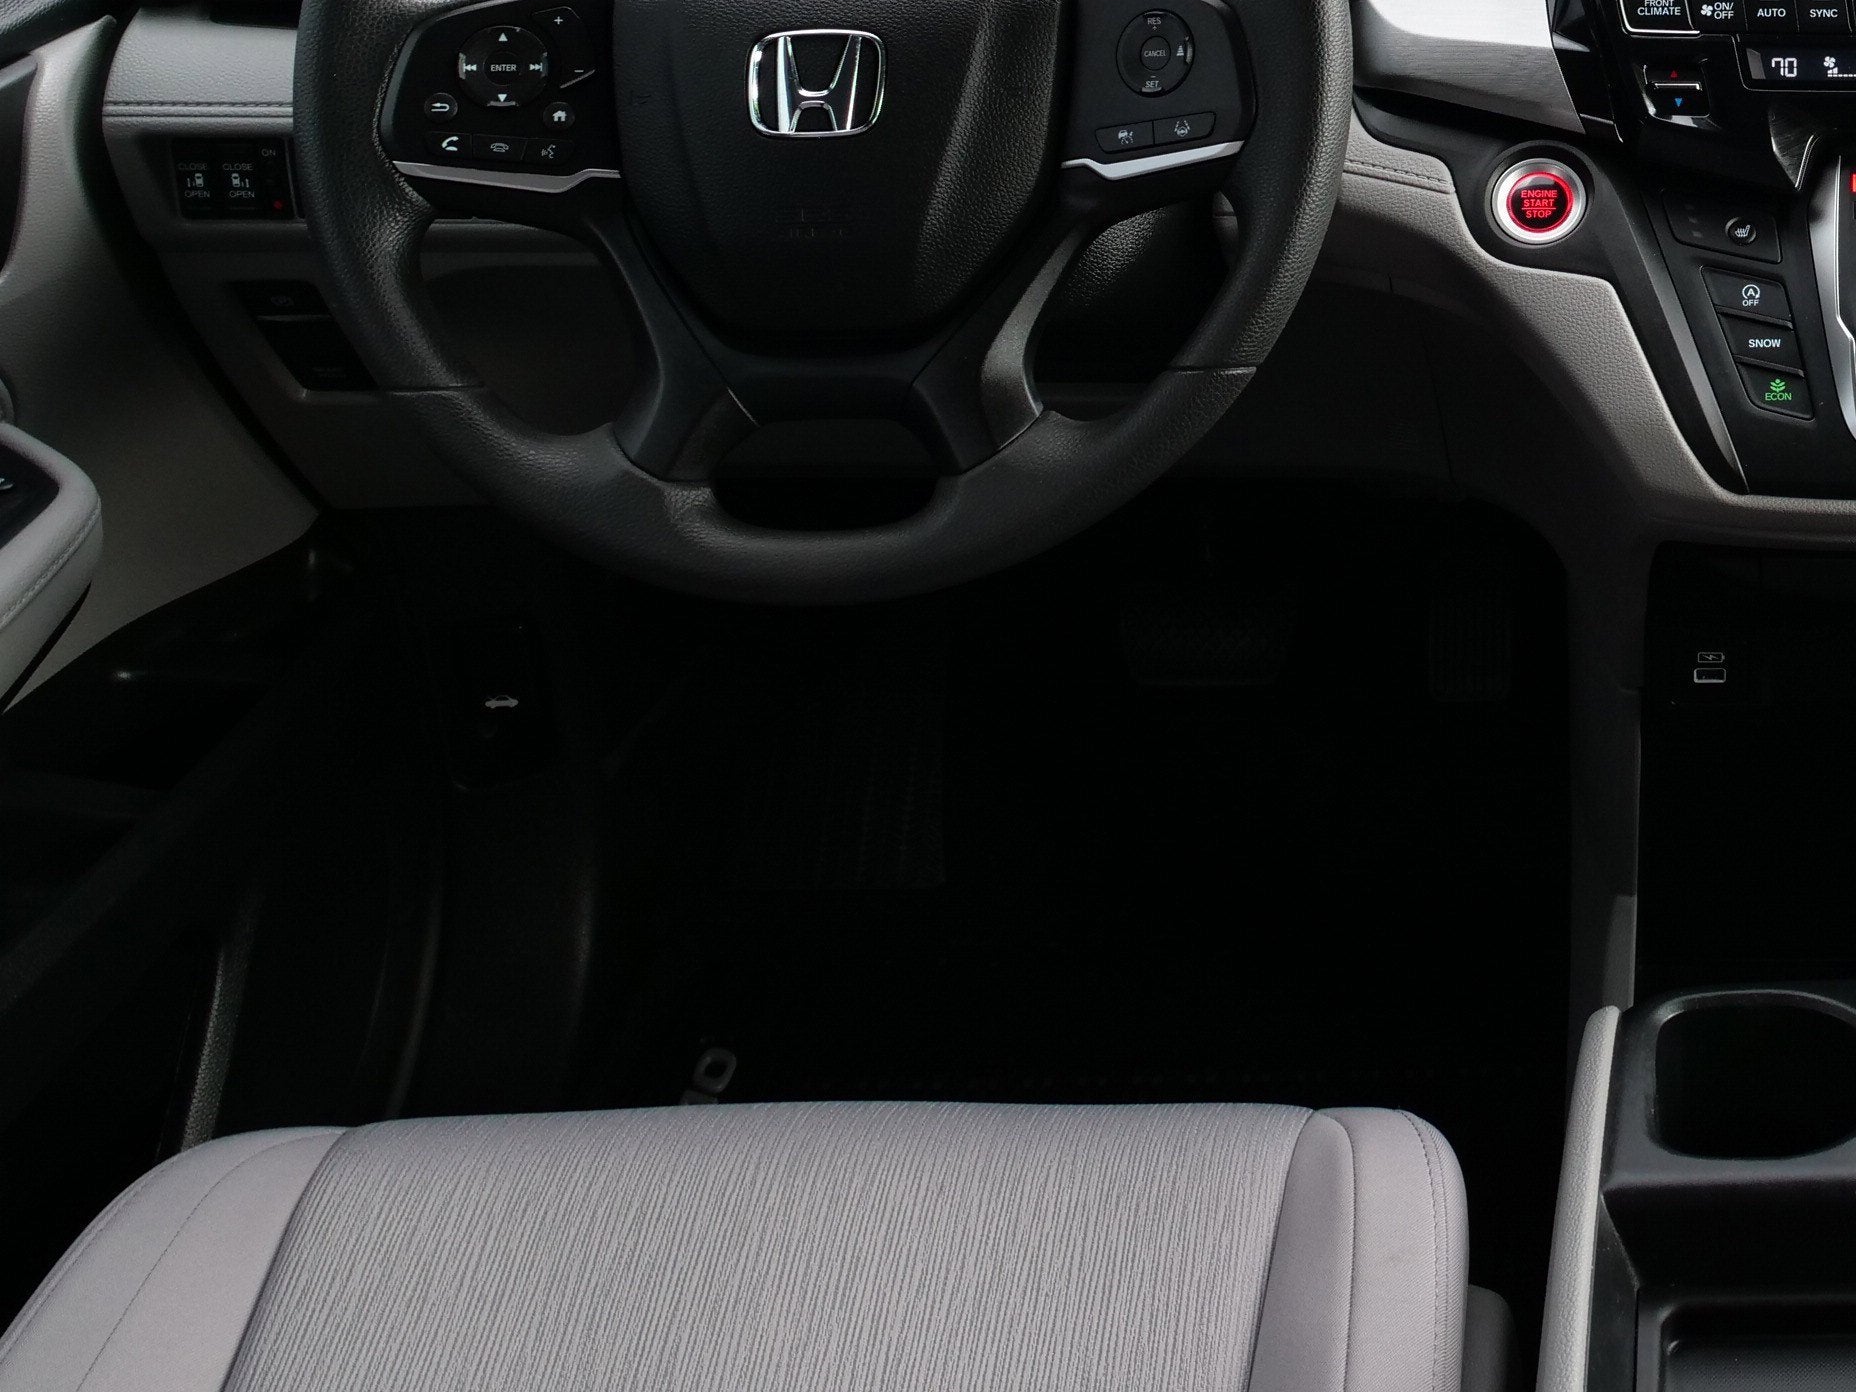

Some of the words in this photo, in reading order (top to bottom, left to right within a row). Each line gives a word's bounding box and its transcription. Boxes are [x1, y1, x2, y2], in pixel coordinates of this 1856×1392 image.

[1644, 0, 1675, 7] FRONT
[1713, 1, 1734, 11] ON/
[1637, 7, 1682, 16] CLIMATE
[1713, 10, 1735, 20] OFF
[1756, 8, 1787, 18] AUTO
[1809, 9, 1839, 19] SYNC
[1147, 17, 1162, 25] RES
[1143, 49, 1166, 58] CANCEL
[490, 63, 517, 72] ENTER
[1144, 80, 1160, 89] SET
[260, 147, 277, 157] ON
[222, 162, 254, 171] CLOSE
[184, 190, 211, 199] OPEN
[229, 189, 256, 199] OPEN
[1521, 189, 1558, 198] ENGINE
[1523, 199, 1555, 207] START
[1525, 210, 1552, 219] STOP
[1742, 299, 1759, 307] OFF
[1748, 338, 1782, 348] SNOW
[1764, 392, 1793, 401] ECON
